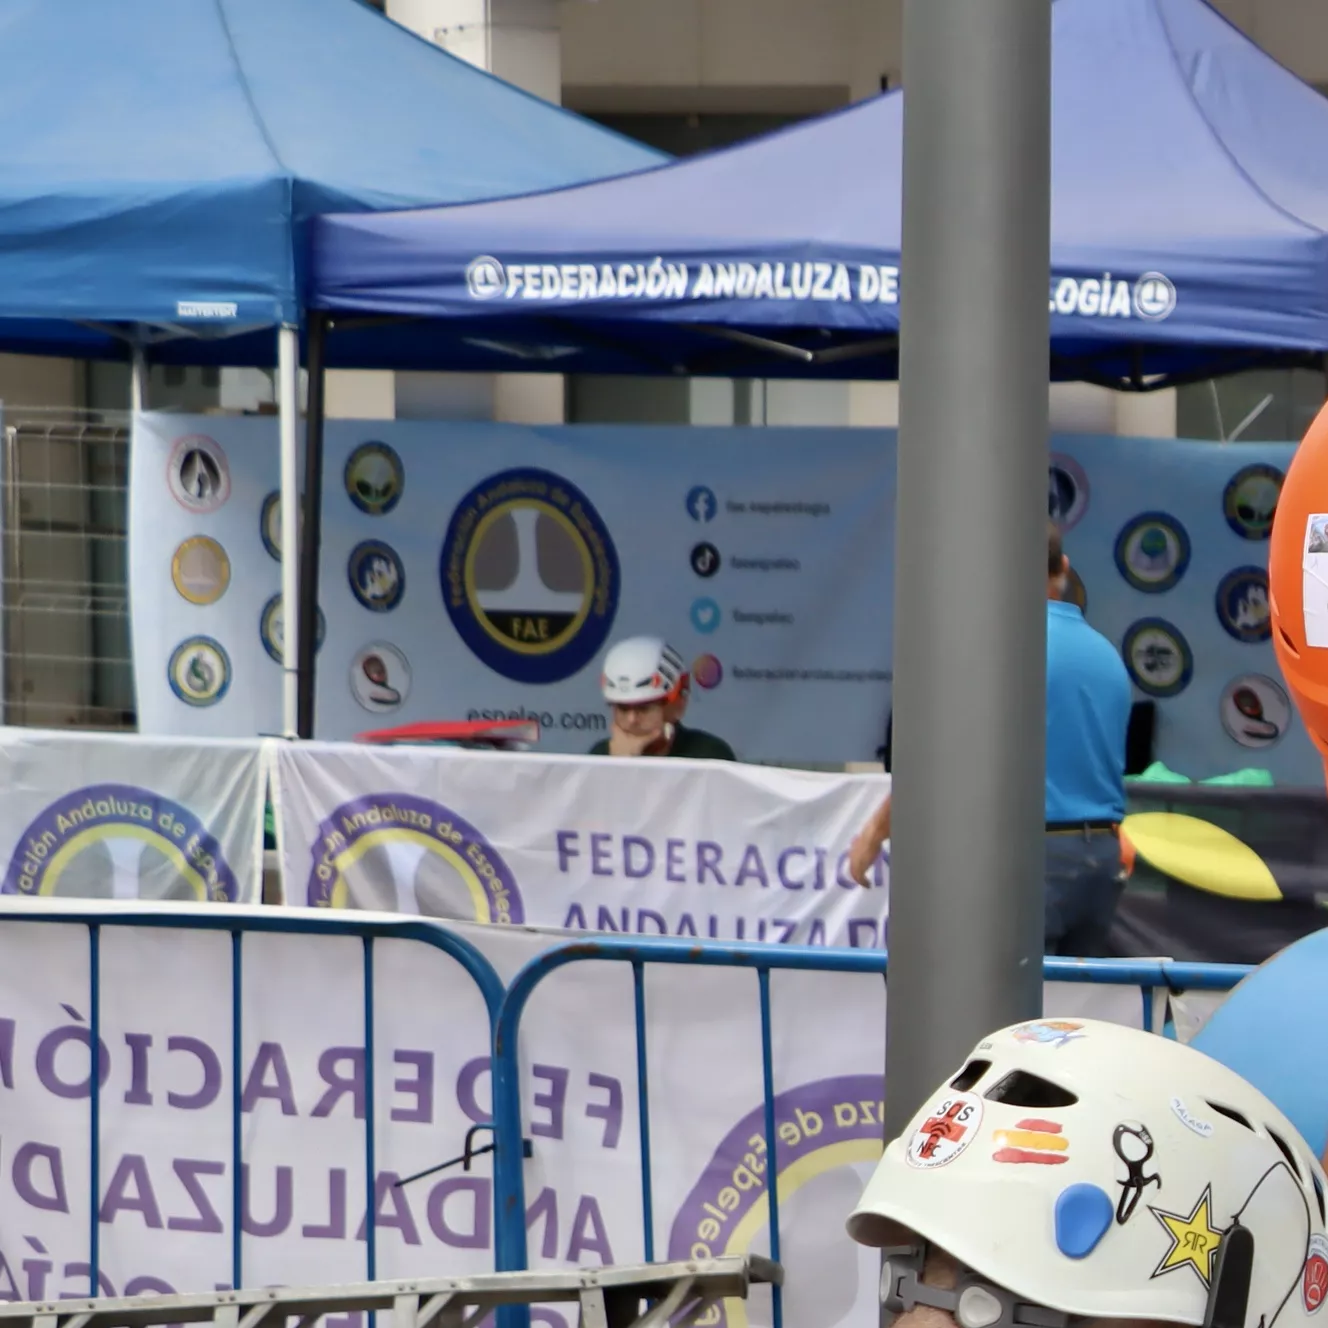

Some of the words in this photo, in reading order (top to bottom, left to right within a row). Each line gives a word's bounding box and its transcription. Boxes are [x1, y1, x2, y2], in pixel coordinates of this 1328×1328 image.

[506, 256, 688, 299] FEDERACIÓN
[692, 262, 852, 301] ANDALUZA
[858, 265, 899, 303] DE
[1049, 272, 1131, 317] OGÍA
[512, 617, 551, 640] FAE
[467, 706, 608, 732] espeleo.com
[342, 803, 433, 835] Andaluza
[436, 821, 464, 844] de
[18, 831, 57, 894] ación
[56, 796, 153, 834] Andaluza
[158, 811, 187, 838] de
[847, 915, 890, 948] D
[936, 1100, 975, 1121] SOS
